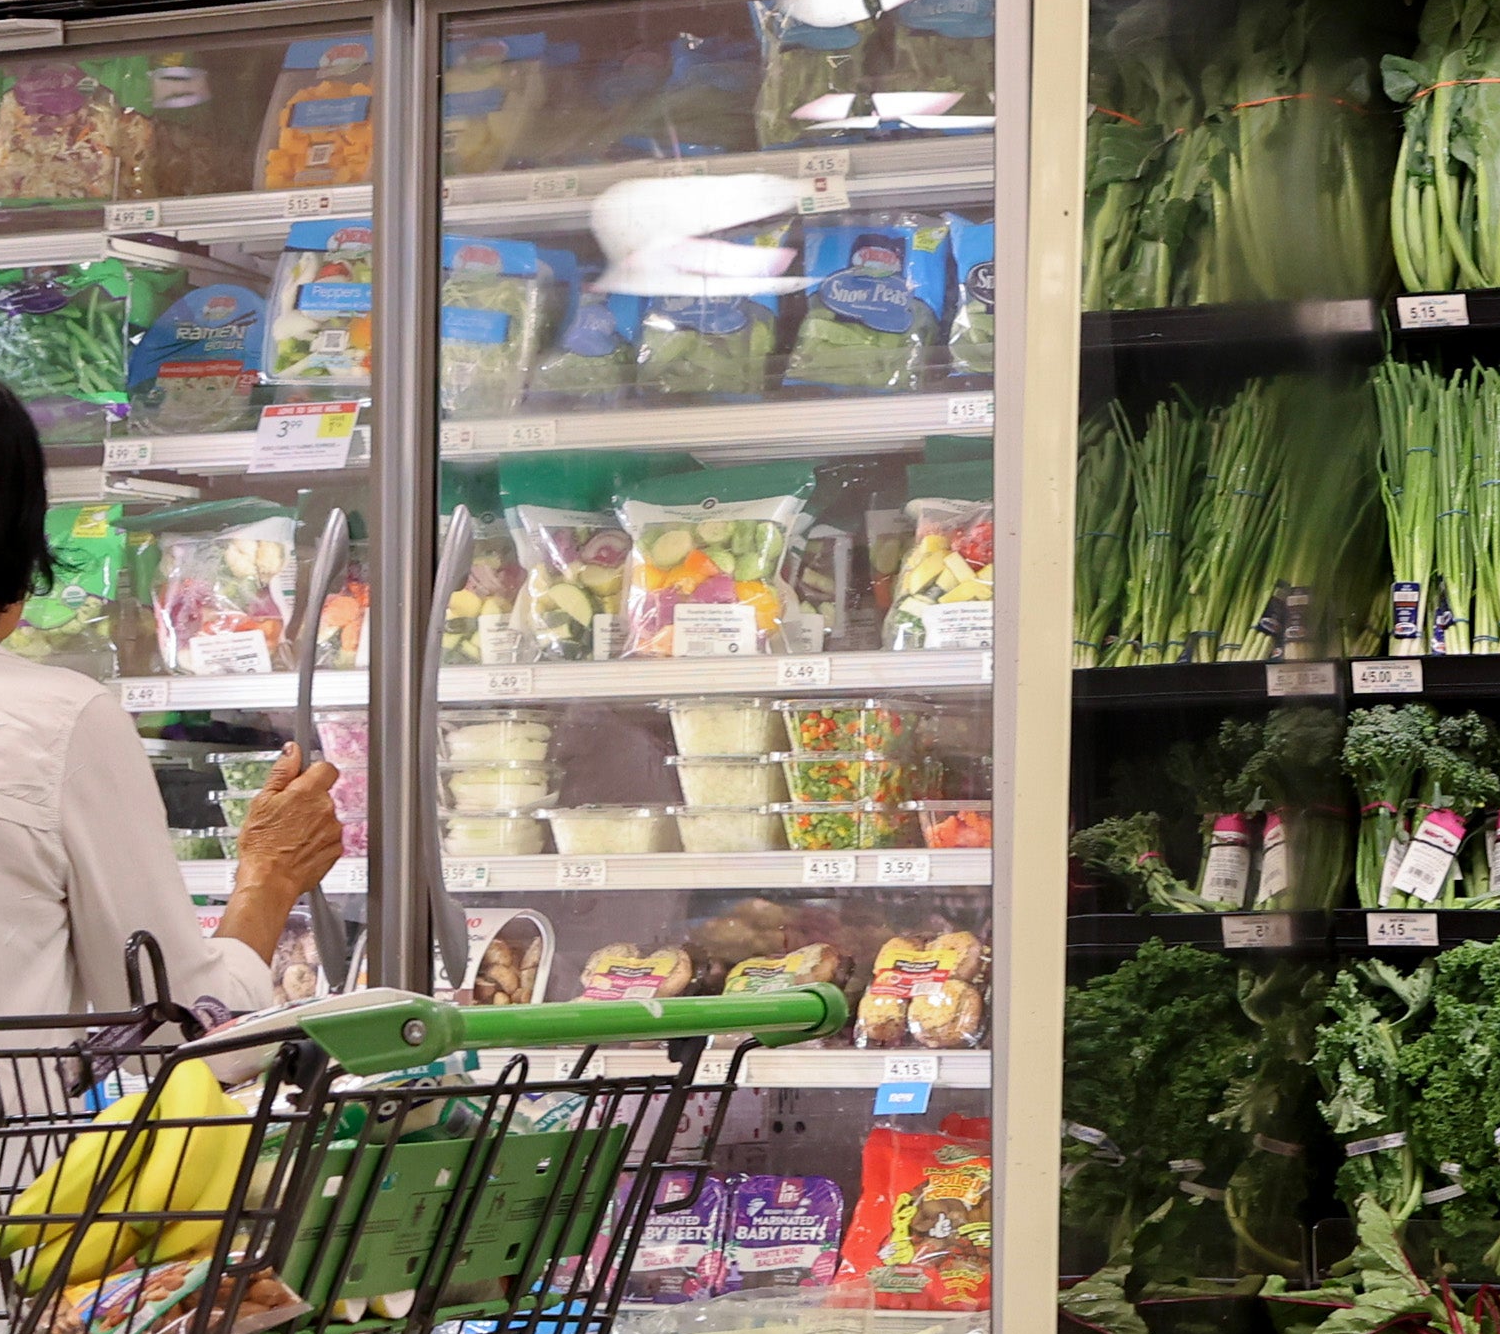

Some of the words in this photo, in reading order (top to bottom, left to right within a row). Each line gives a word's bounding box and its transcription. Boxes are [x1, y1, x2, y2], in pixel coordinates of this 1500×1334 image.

[806, 158, 836, 171] 4.15
[311, 285, 362, 299] Peppers
[829, 279, 868, 303] Snow
[872, 283, 908, 306] Peas
[1409, 307, 1437, 320] 5.15
[784, 666, 815, 679] 6.49
[562, 866, 592, 878] 3.59
[809, 862, 841, 874] 4.15
[883, 861, 914, 874] 3.59
[1378, 924, 1405, 936] 4.15
[889, 1063, 921, 1076] 4.15
[645, 1215, 701, 1226] ARINATED
[751, 1215, 816, 1226] MARINATED
[666, 1226, 712, 1241] BEETS
[735, 1225, 780, 1241] BABY
[780, 1225, 827, 1241] BEETS
